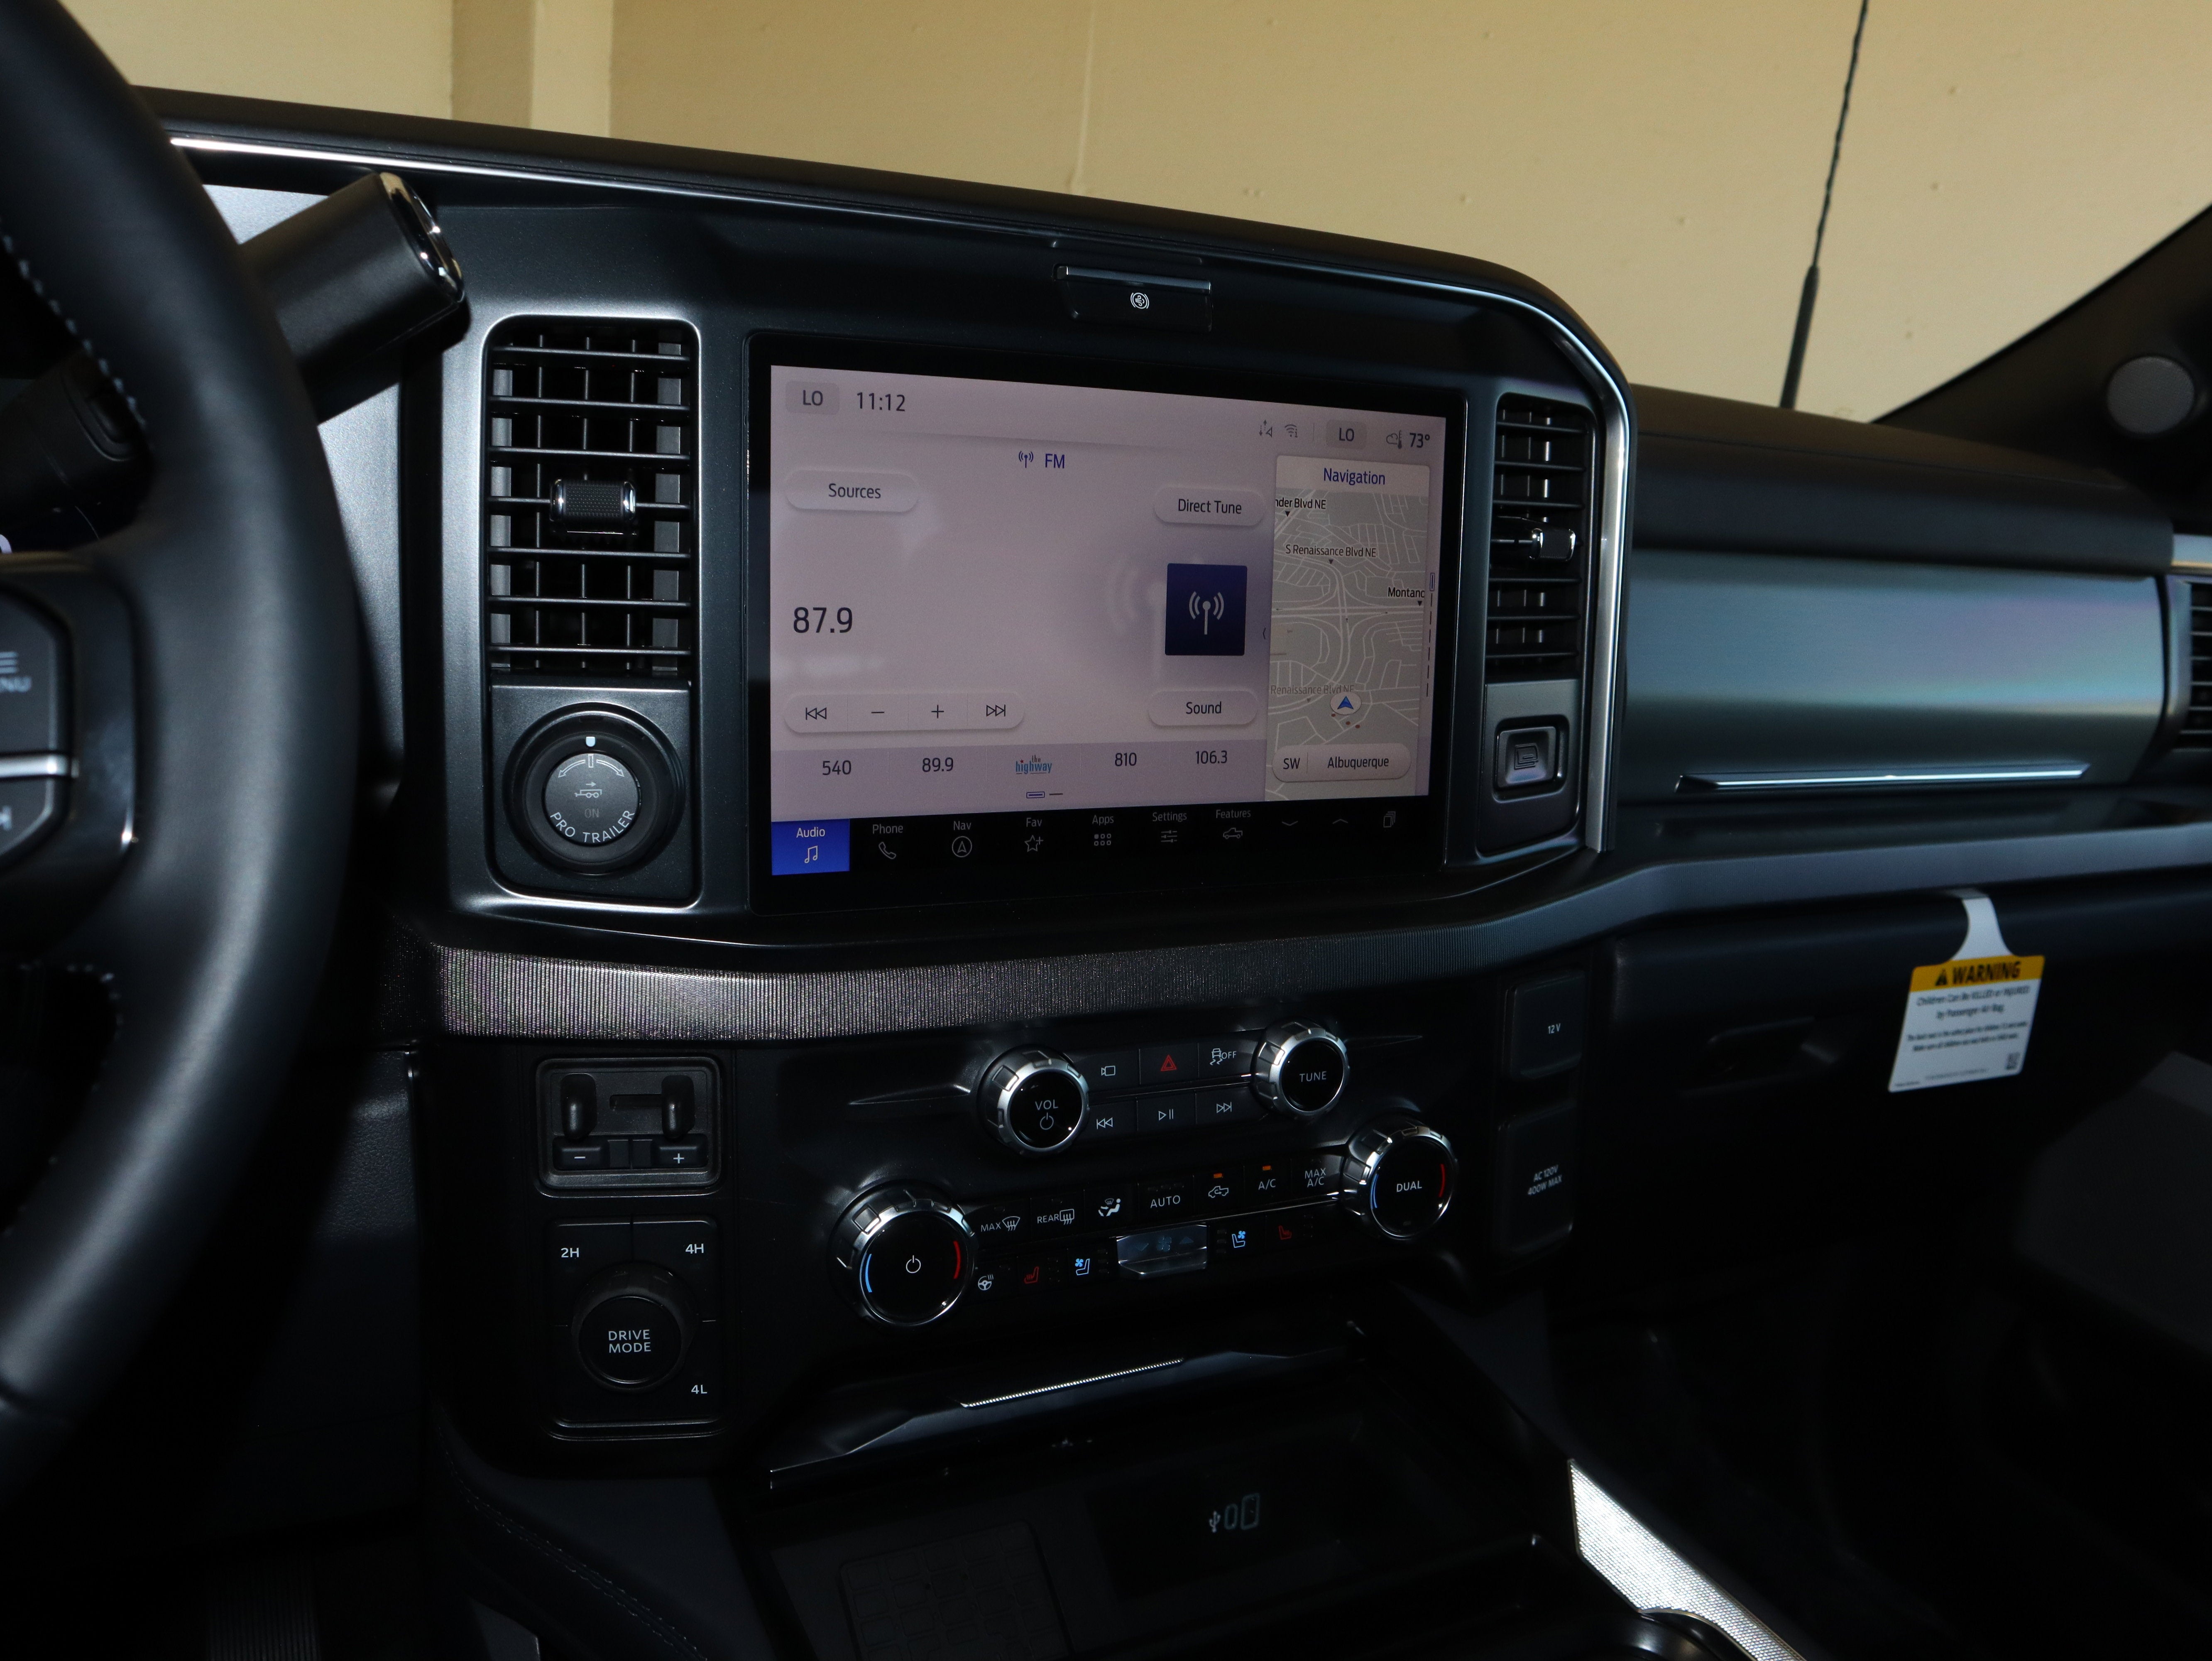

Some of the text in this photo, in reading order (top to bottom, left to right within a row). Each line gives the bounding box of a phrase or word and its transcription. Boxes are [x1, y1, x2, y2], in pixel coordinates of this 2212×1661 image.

[803, 390, 823, 407] LO
[856, 392, 906, 412] 11:12
[1339, 428, 1355, 442] LO
[1409, 433, 1431, 449] 73°
[1045, 453, 1066, 469] FM
[1323, 468, 1386, 485] Navigation
[828, 483, 881, 499] Sources
[1178, 499, 1242, 515] Direct Tune
[1294, 498, 1312, 509] Blvd
[1315, 499, 1326, 509] NE
[1285, 544, 1377, 557] S Renaissance Blvd NE
[793, 607, 854, 634] 87.9
[1270, 685, 1322, 695] Renaissance
[1324, 684, 1341, 694] Blvd
[1185, 701, 1222, 715] Sound
[1032, 755, 1041, 763] the
[1115, 752, 1137, 767] 810
[1196, 750, 1228, 765] 106.3
[1283, 758, 1300, 769] SW
[1327, 757, 1389, 770] Albuquerque
[822, 760, 852, 776] 540
[922, 757, 954, 772] 89.9
[1015, 760, 1052, 774] highway
[585, 808, 599, 818] ON
[1152, 810, 1187, 822] Settings
[1216, 808, 1251, 819] Features
[953, 821, 972, 831] Nav
[1026, 817, 1042, 827] Fav
[1092, 814, 1114, 826] Apps
[550, 810, 635, 843] PRO TRAILER
[796, 827, 826, 838] Audio
[872, 824, 904, 834] Phone
[1952, 961, 2021, 985] WARNING
[1221, 1049, 1237, 1060] OFF
[1299, 1071, 1327, 1083] TUNE
[1035, 1100, 1059, 1110] VOL
[1304, 1167, 1326, 1179] MAX
[1533, 1164, 1559, 1182] AC 120V
[1258, 1178, 1276, 1190] A/C
[1307, 1177, 1325, 1188] A/C
[1396, 1180, 1422, 1193] DUAL
[1527, 1173, 1562, 1196] 400W MAX
[1150, 1195, 1181, 1208] AUTO
[1037, 1213, 1060, 1224] REAR
[981, 1222, 1001, 1232] MAX
[561, 1247, 580, 1258] 2H
[685, 1243, 704, 1254] 4H
[608, 1329, 651, 1341] DRIVE
[608, 1341, 651, 1353] MODE
[690, 1384, 707, 1395] 4L
